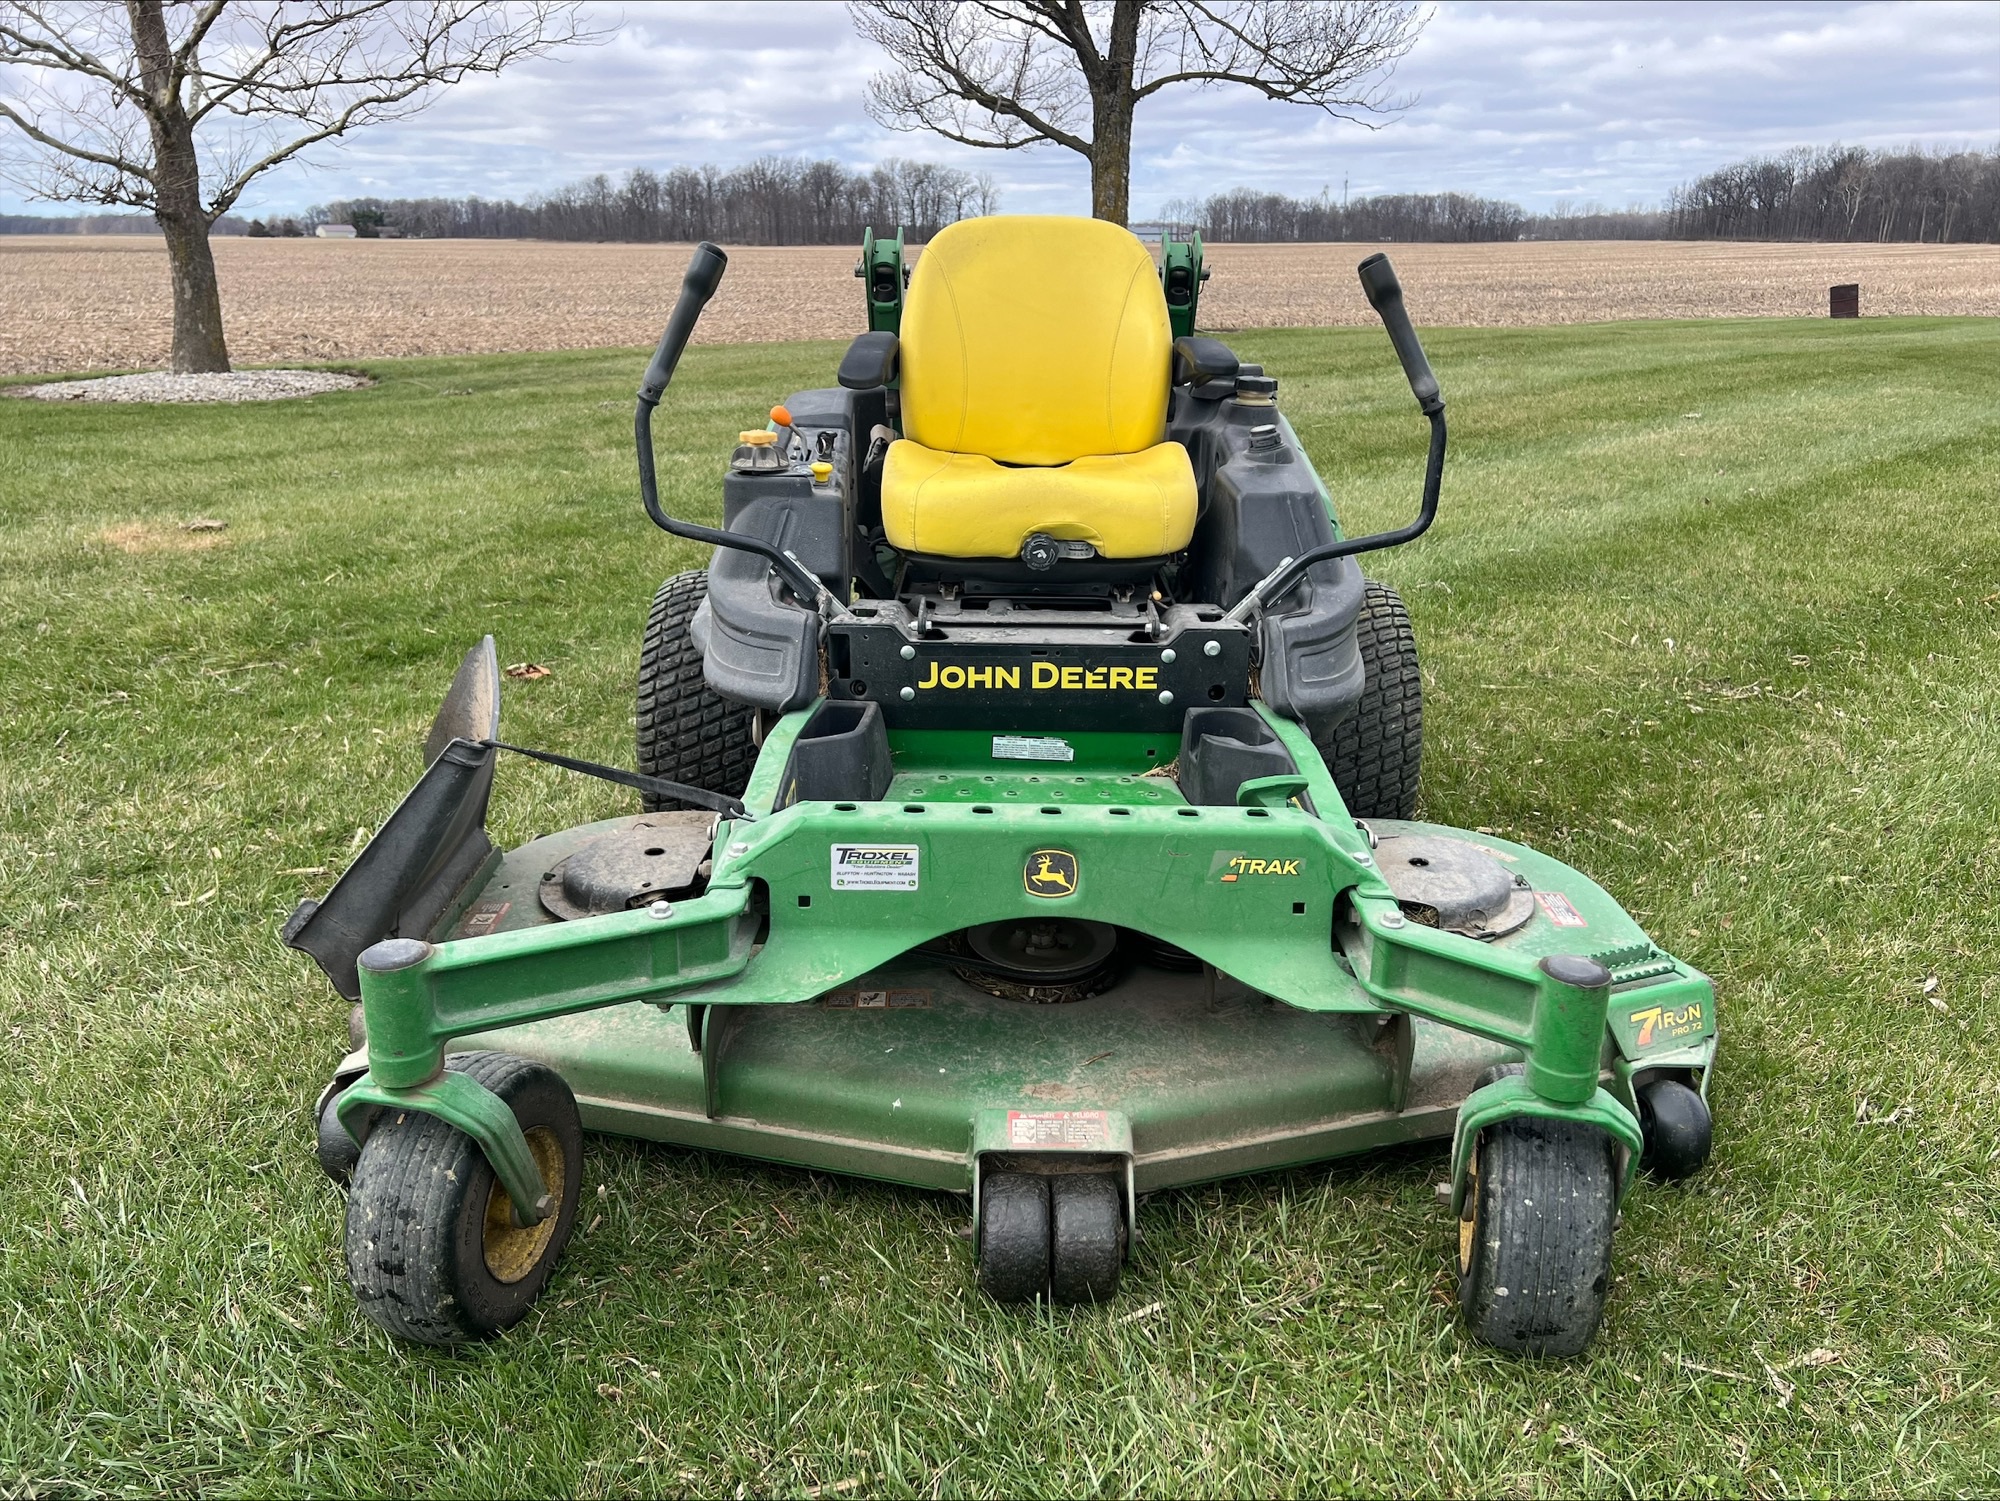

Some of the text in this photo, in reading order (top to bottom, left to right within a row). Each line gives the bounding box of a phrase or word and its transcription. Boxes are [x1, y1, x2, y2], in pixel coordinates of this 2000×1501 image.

[918, 661, 1158, 690] JOHN DEERE
[836, 847, 914, 864] TROXEL
[1672, 1022, 1703, 1037] PRO 72
